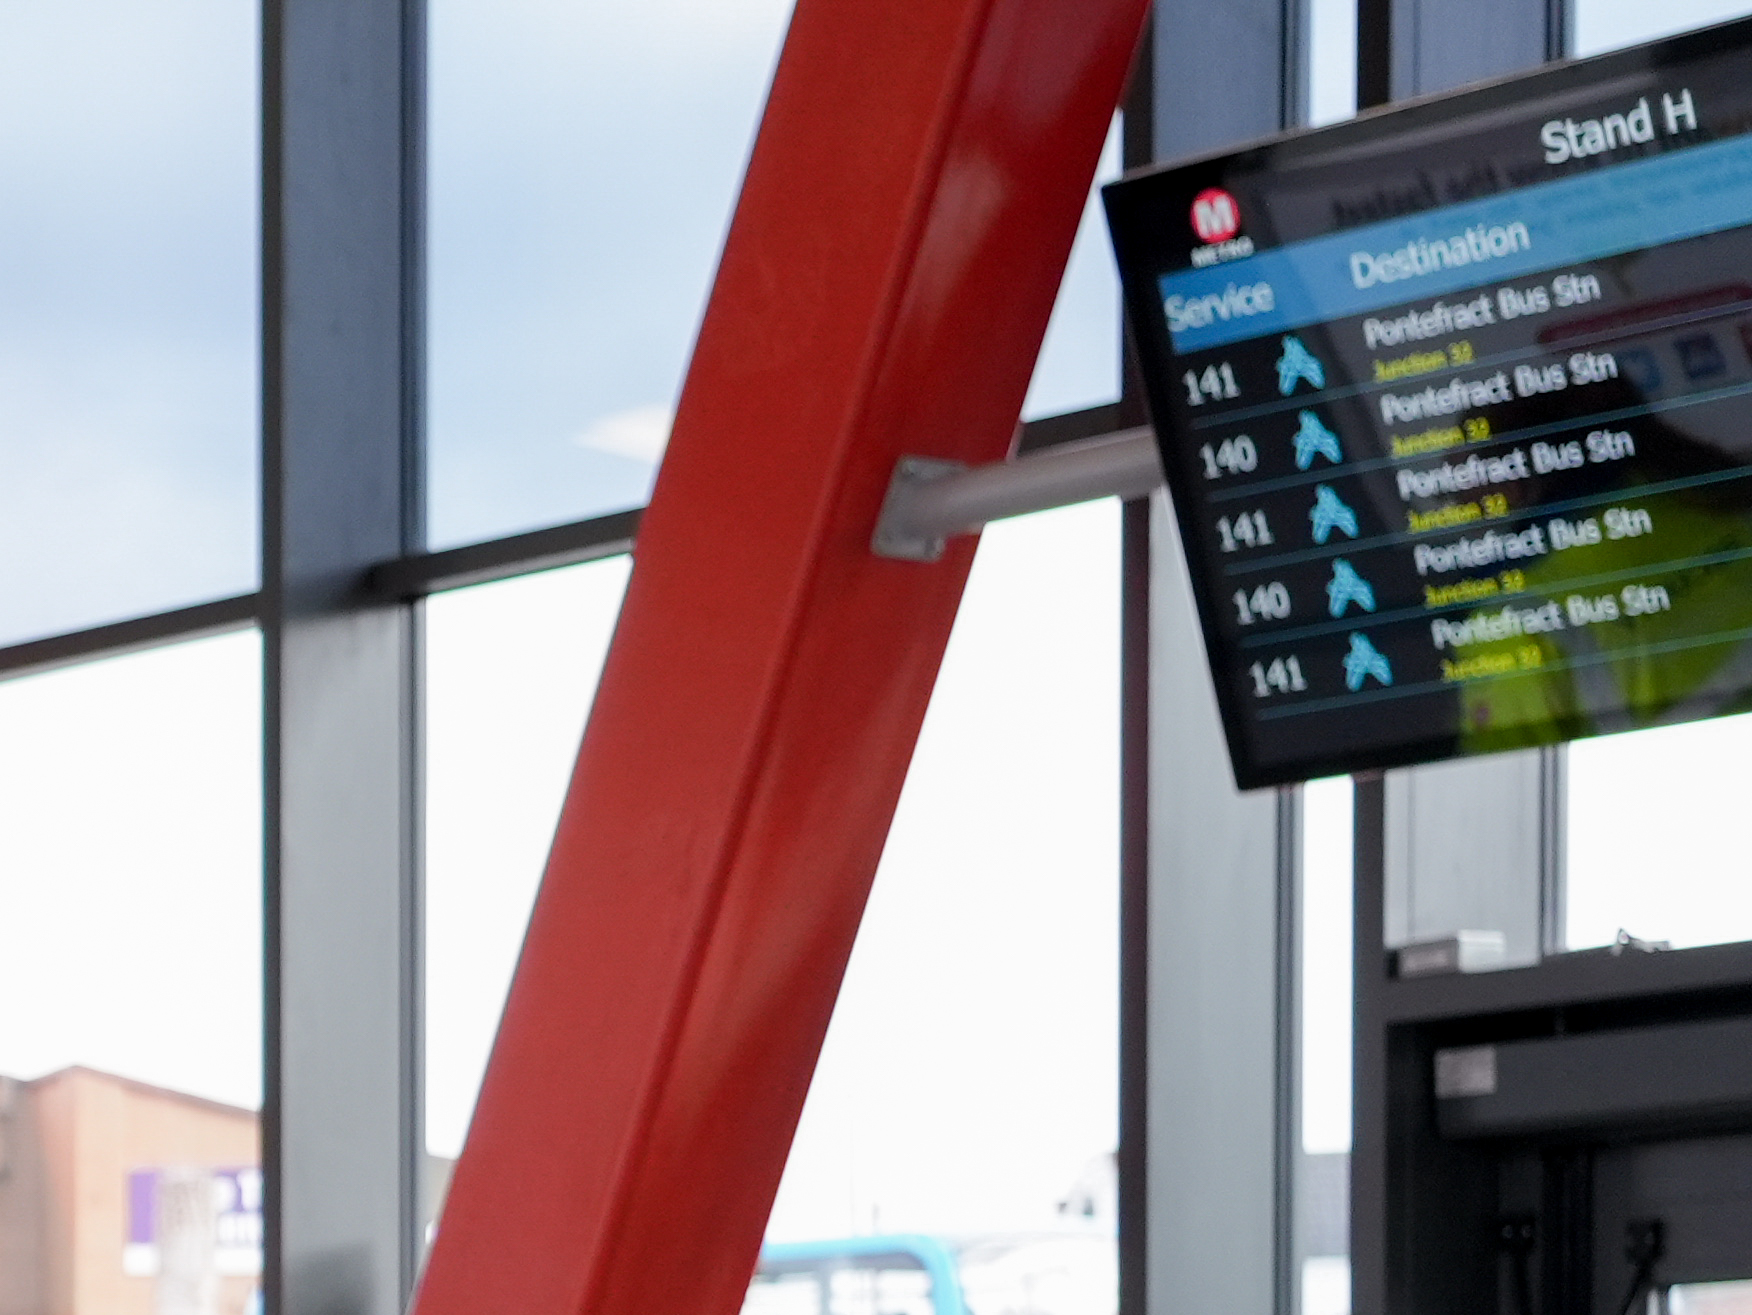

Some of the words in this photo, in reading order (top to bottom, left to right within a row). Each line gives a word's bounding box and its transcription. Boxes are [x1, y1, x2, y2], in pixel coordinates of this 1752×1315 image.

[1542, 96, 1654, 165] Stand
[1661, 90, 1697, 133] H
[1164, 280, 1273, 333] Service
[1350, 218, 1530, 290] Destination
[1193, 195, 1236, 239] M
[1183, 361, 1239, 407] 141
[1363, 296, 1491, 349] Pontefract
[1496, 280, 1550, 320] Bus
[1552, 271, 1600, 307] Stn
[1200, 436, 1257, 480] 140
[1380, 373, 1510, 426] Pontefract
[1514, 357, 1566, 397] Bus
[1569, 349, 1616, 384] Stn
[1217, 509, 1273, 553] 141
[1398, 450, 1526, 502] Pontefract
[1531, 434, 1583, 475] Bus
[1585, 426, 1633, 463] Stn
[1234, 582, 1291, 625] 140
[1414, 525, 1544, 577] Pontefract
[1548, 511, 1600, 552] Bus
[1603, 504, 1651, 539] Stn
[1250, 655, 1307, 698] 141
[1432, 602, 1560, 650] Pontefract
[1566, 587, 1617, 628] Bus
[1619, 580, 1669, 616] Stn
